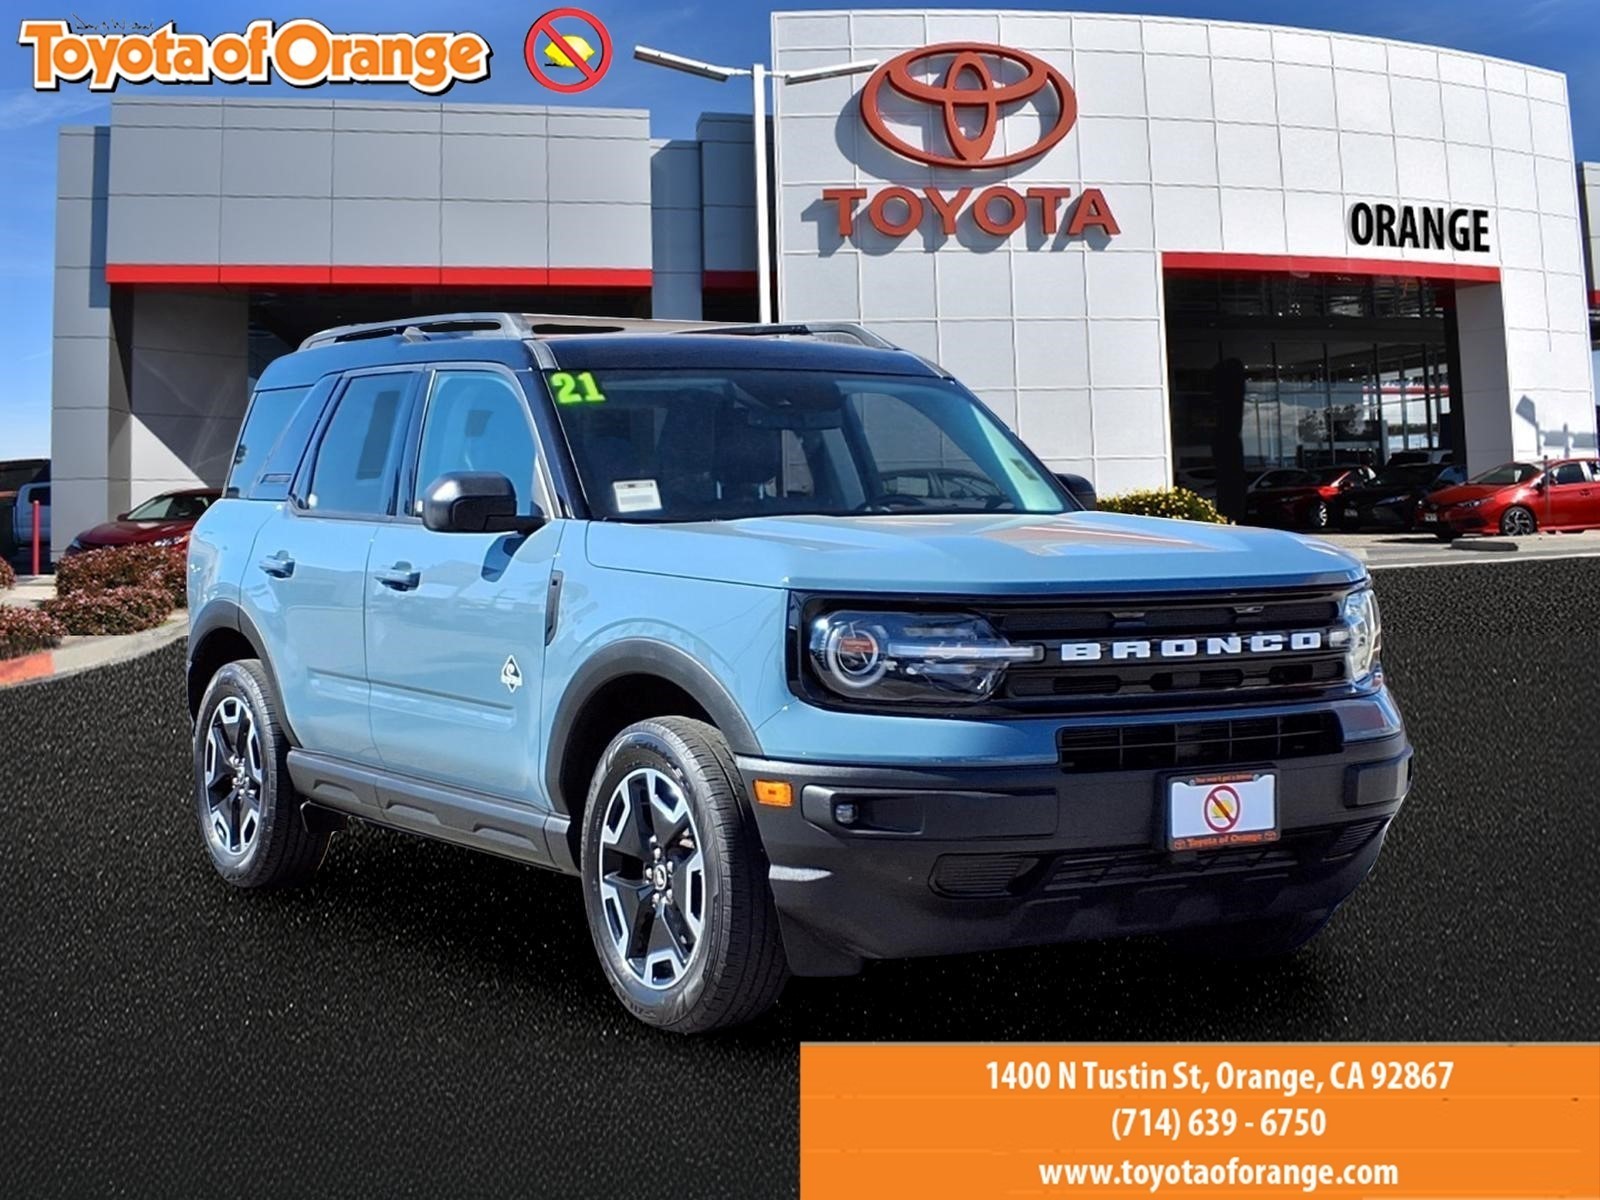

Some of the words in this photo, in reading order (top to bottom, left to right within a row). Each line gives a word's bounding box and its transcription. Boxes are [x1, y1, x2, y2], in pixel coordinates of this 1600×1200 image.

[822, 186, 1121, 238] TOYOTA
[1350, 201, 1491, 253] ORANGE
[551, 371, 607, 404] 21
[1060, 631, 1322, 662] BRONCO
